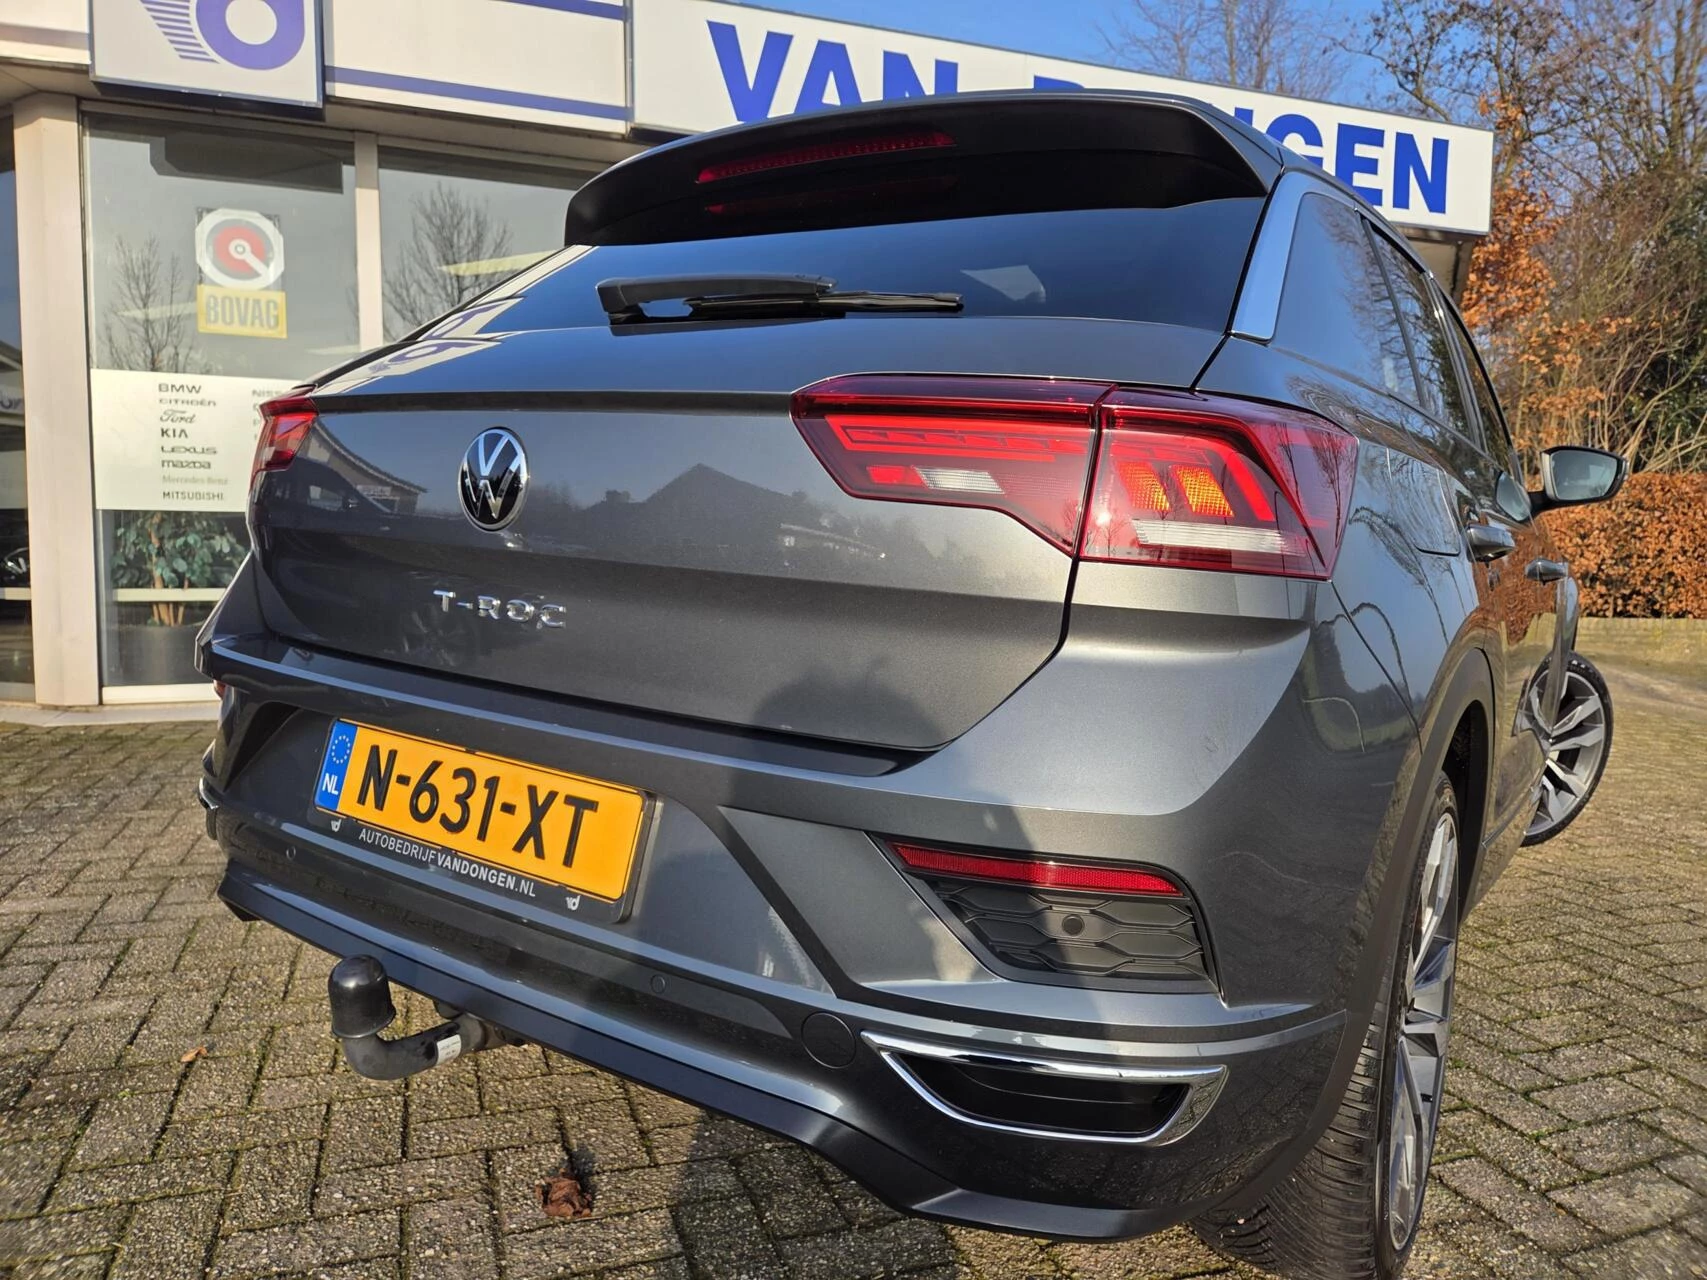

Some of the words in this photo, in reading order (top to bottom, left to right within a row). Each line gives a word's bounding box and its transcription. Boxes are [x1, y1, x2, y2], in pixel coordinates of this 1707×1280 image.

[205, 294, 280, 330] BOVAG
[158, 383, 202, 394] BMW
[159, 409, 196, 424] Ford
[160, 427, 189, 439] KIA
[161, 446, 217, 455] LEXUS
[162, 491, 225, 501] MITSUBISHI
[433, 589, 567, 628] T-ROC
[322, 773, 340, 796] NL
[356, 744, 600, 868] N-631-XT
[358, 827, 537, 898] AUTOBEDRIJFVANDONGEN.NL
